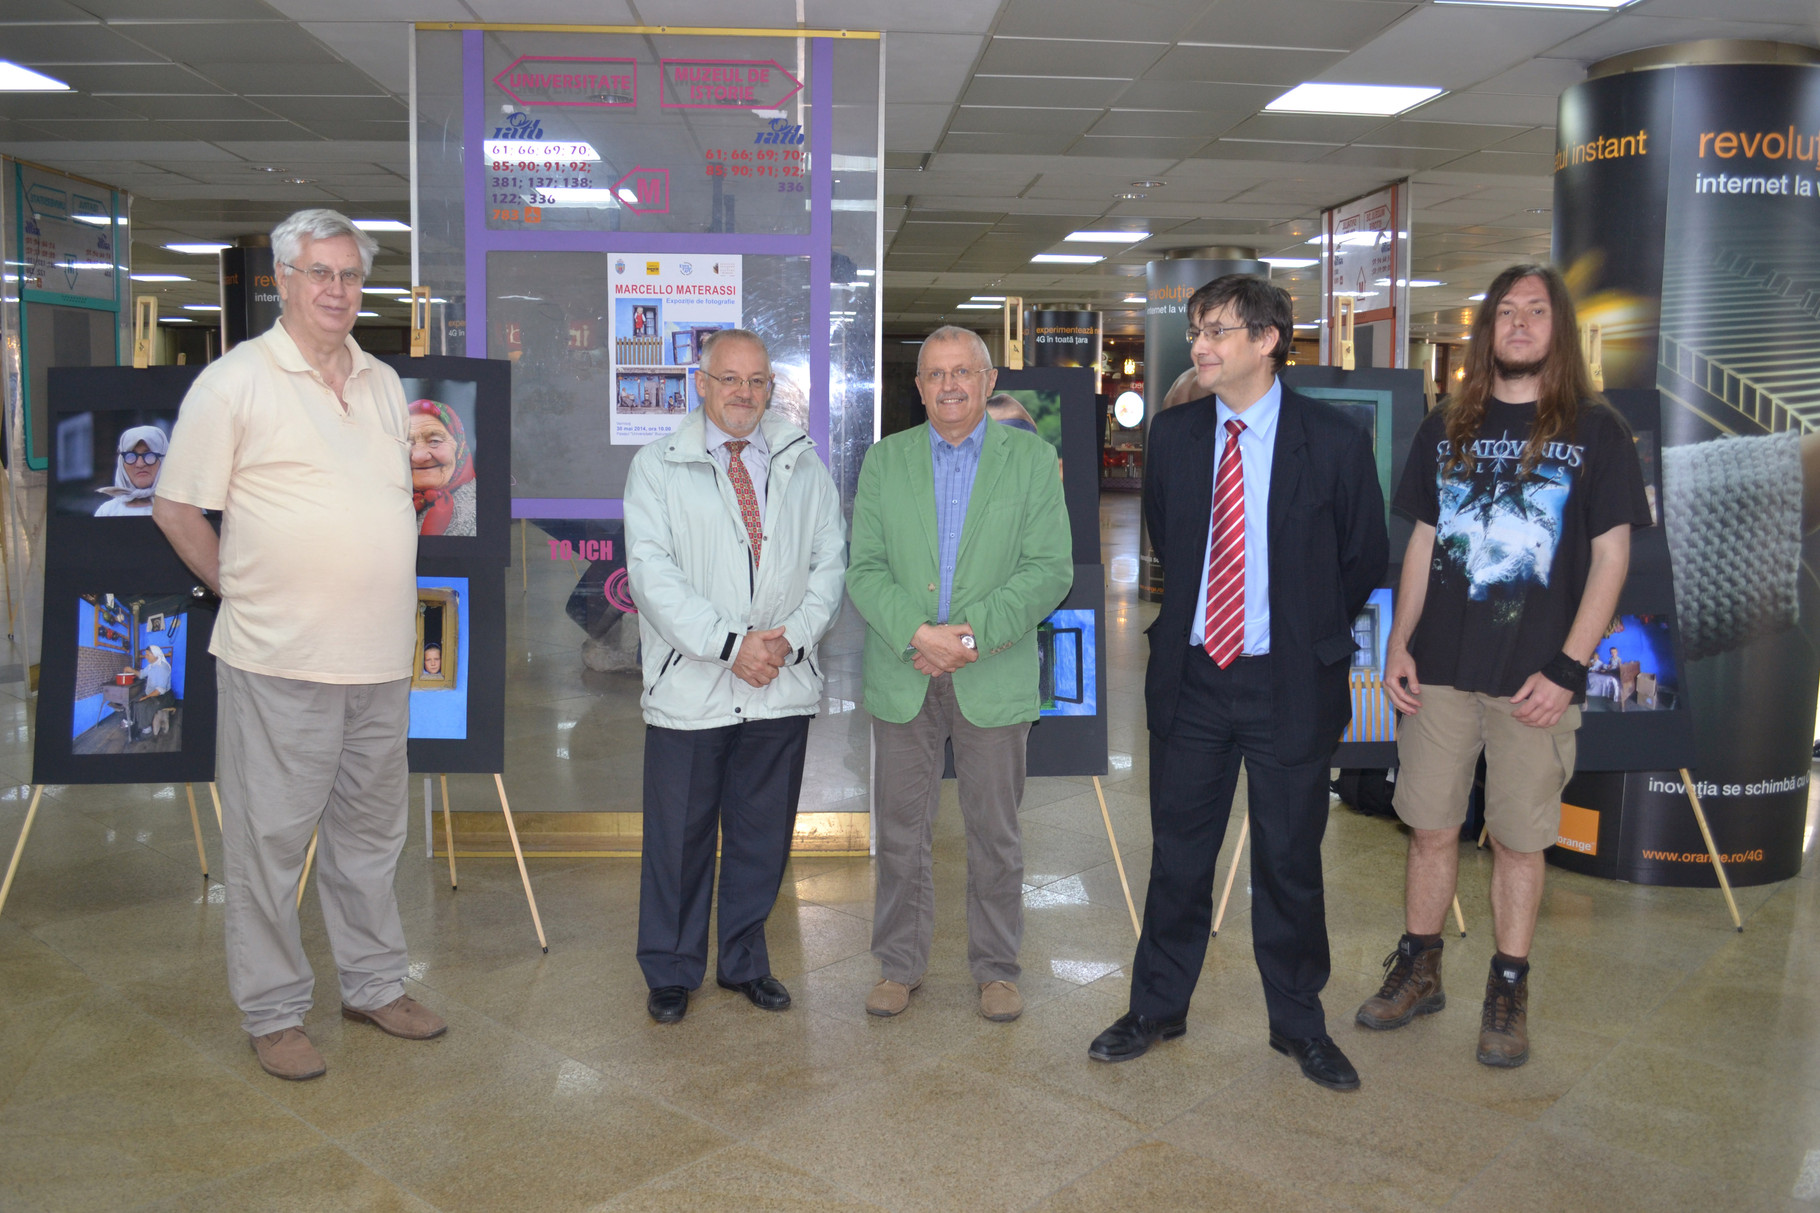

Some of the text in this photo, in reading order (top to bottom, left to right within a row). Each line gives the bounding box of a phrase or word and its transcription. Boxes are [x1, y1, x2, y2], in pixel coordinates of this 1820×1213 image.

[510, 73, 630, 90] UNIVERSITATE
[675, 67, 770, 83] MUZEUL DE
[690, 85, 754, 100] ISTORIE
[492, 145, 591, 157] 61; 66; 69; 70;
[1571, 129, 1647, 166] instant
[706, 149, 804, 162] 61; 66; 69; 70;
[492, 161, 591, 173] 85; 90; 91; 92;
[706, 165, 804, 178] 85; 90; 91; 92;
[492, 177, 593, 189] 381; 137; 138;
[778, 182, 804, 193] 336
[1695, 172, 1811, 197] internet la
[637, 178, 660, 204] M
[492, 193, 556, 206] 122; 336
[492, 209, 519, 221] 783
[615, 284, 736, 296] MARCELLO MATERASSI
[705, 298, 736, 306] fotografie
[1168, 304, 1177, 314] la
[1055, 335, 1073, 344] toată
[1648, 777, 1718, 799] inovţia
[1721, 783, 1742, 797] se
[1744, 775, 1796, 796] schimbă
[1557, 835, 1592, 852] orange
